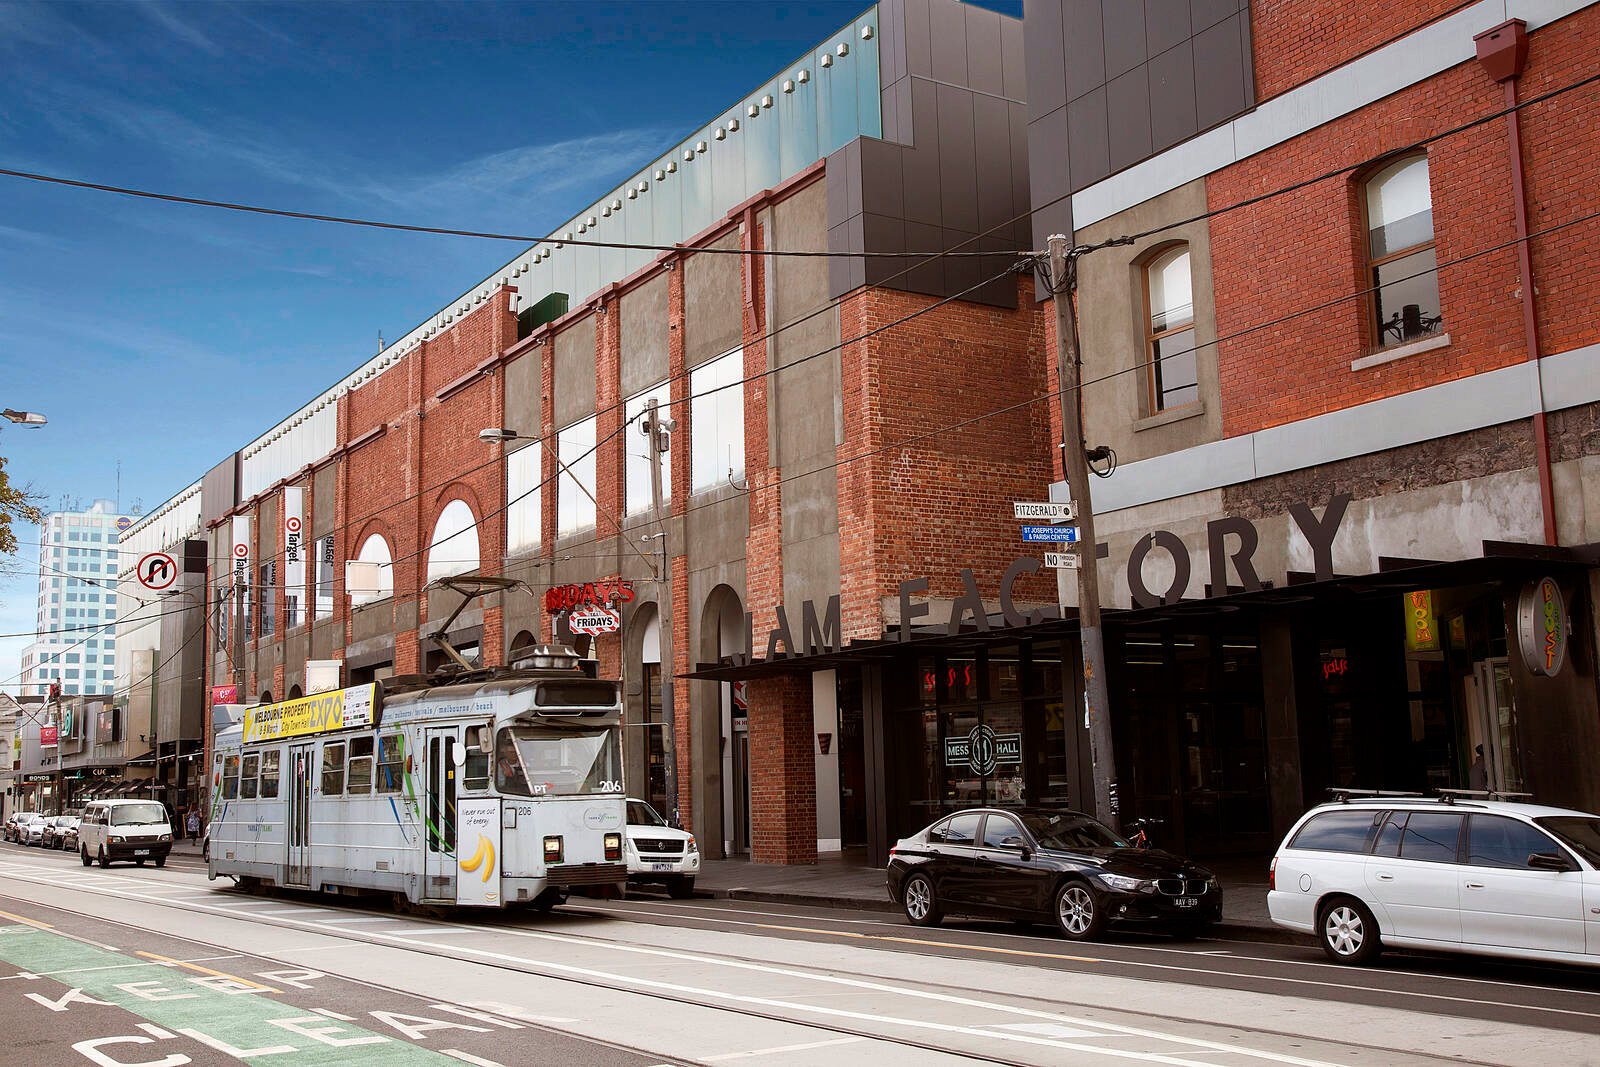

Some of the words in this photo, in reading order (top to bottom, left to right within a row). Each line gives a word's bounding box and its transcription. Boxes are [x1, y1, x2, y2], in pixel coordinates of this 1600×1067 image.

[1015, 505, 1057, 516] FITZGERALD
[1046, 554, 1058, 566] NO
[900, 493, 1351, 642] FACORY
[1542, 583, 1557, 670] BOOST
[254, 706, 284, 724] MELBOURNE
[284, 702, 311, 719] PROPERTY
[948, 745, 969, 756] MESS
[996, 742, 1019, 754] HALL
[600, 781, 621, 792] 206
[518, 807, 532, 816] 206
